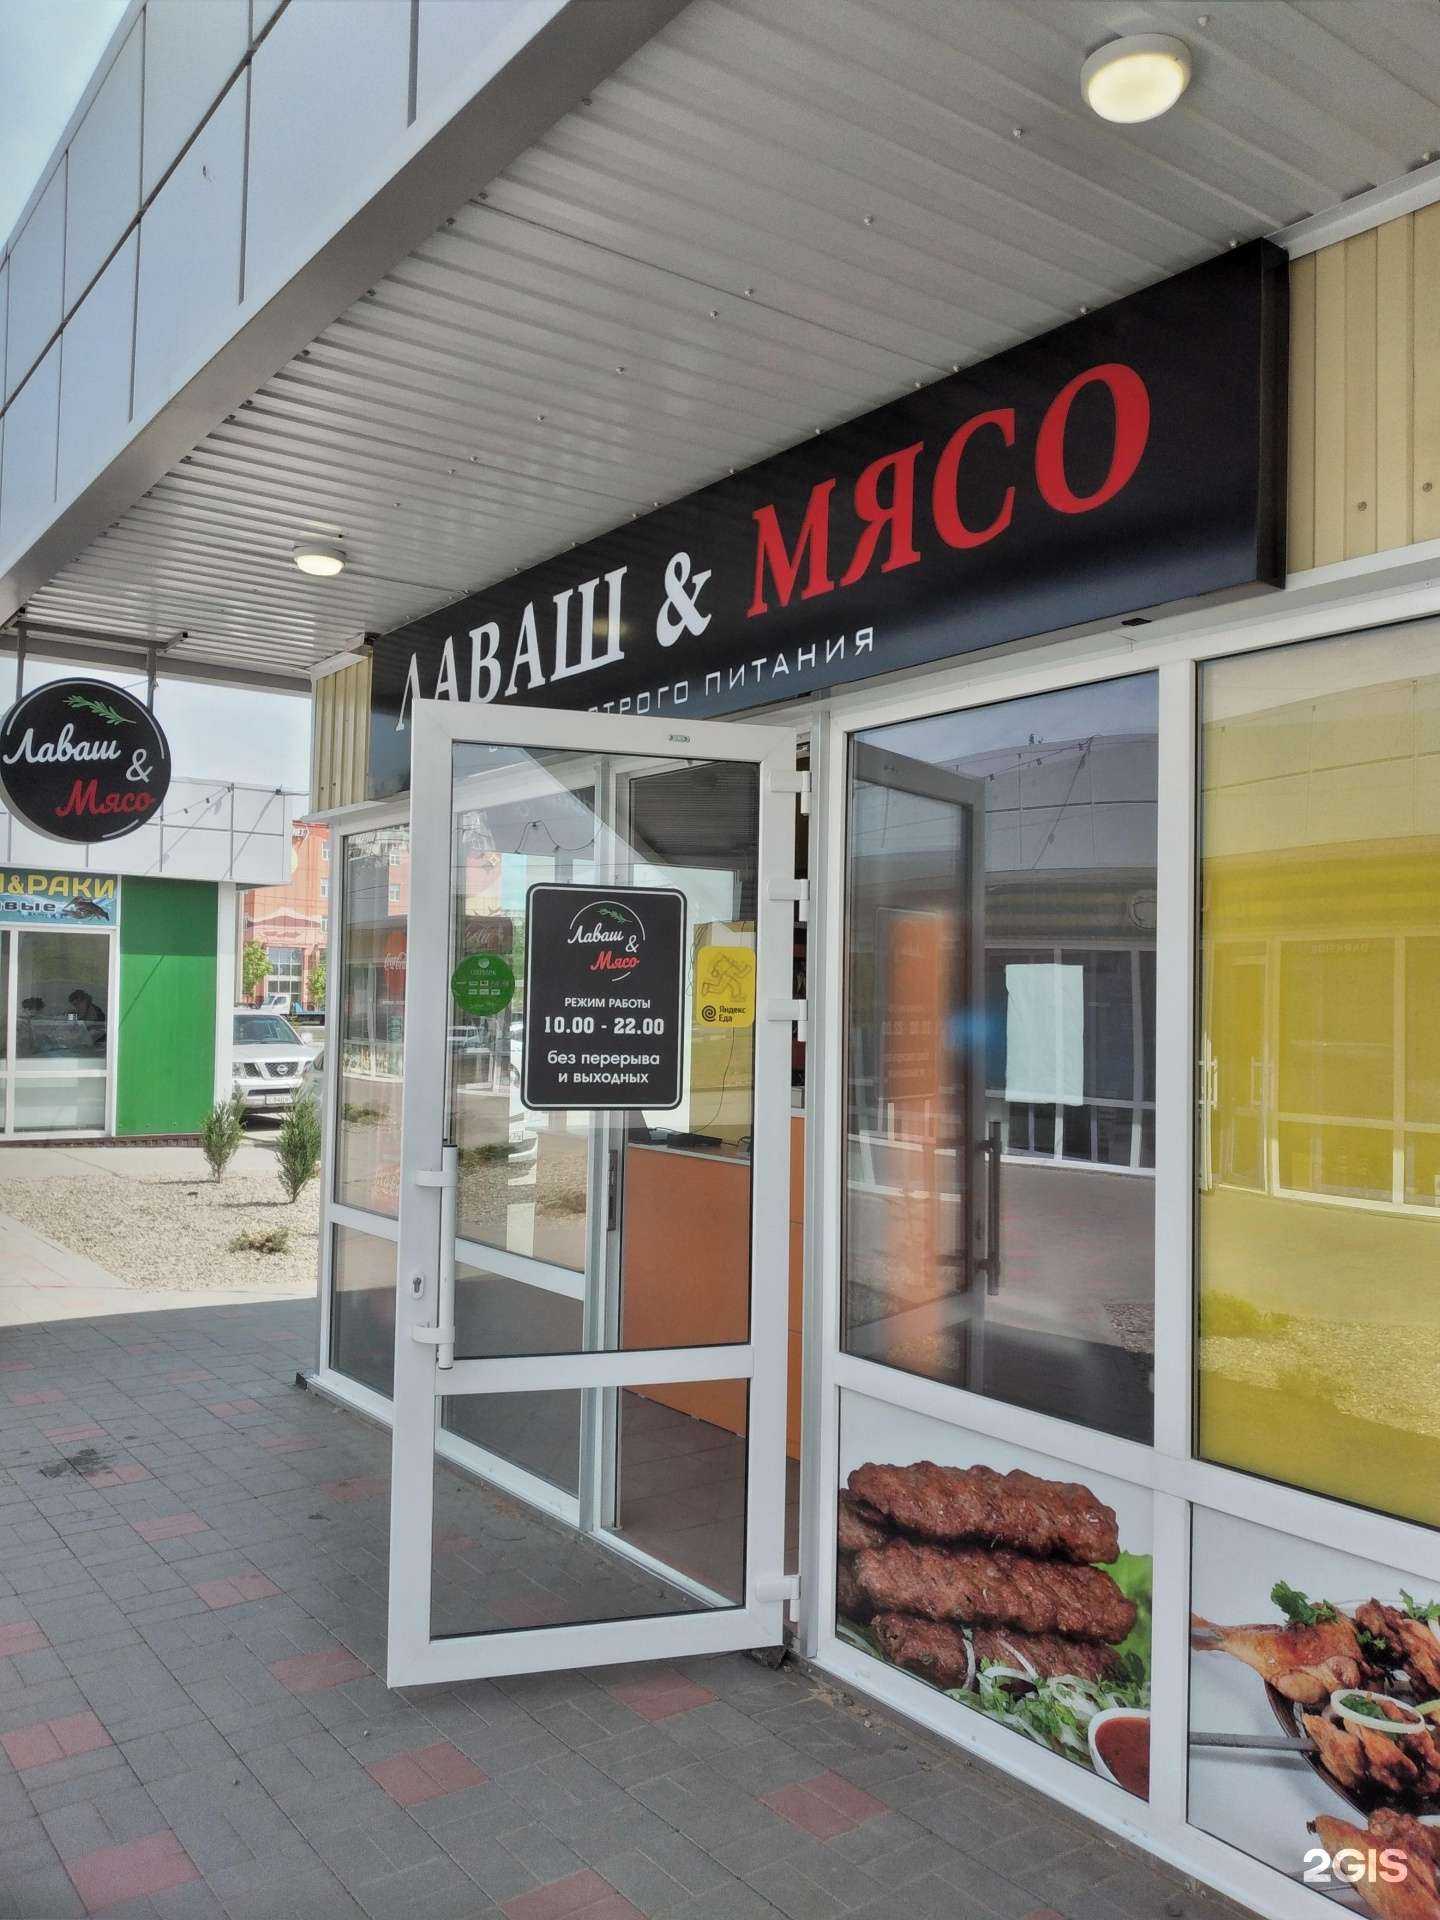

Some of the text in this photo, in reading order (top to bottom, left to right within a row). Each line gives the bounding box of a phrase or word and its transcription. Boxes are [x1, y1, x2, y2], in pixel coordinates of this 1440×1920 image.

[395, 362, 1151, 732] ЛАВАШ & МЯСО
[705, 626, 875, 697] ПИТАНИЯ
[3, 723, 153, 783] Лаваш &
[55, 778, 157, 817] Мясо
[567, 922, 640, 953] Лаваш &
[590, 950, 640, 971] Мясо
[564, 996, 652, 1009] РЕЖИМ РАБОТЫ
[718, 1004, 746, 1015] Яндекс
[544, 1015, 595, 1034] 10.00
[613, 1017, 665, 1035] 22.00
[718, 1014, 733, 1023] Еда
[547, 1050, 661, 1068] без перерыва
